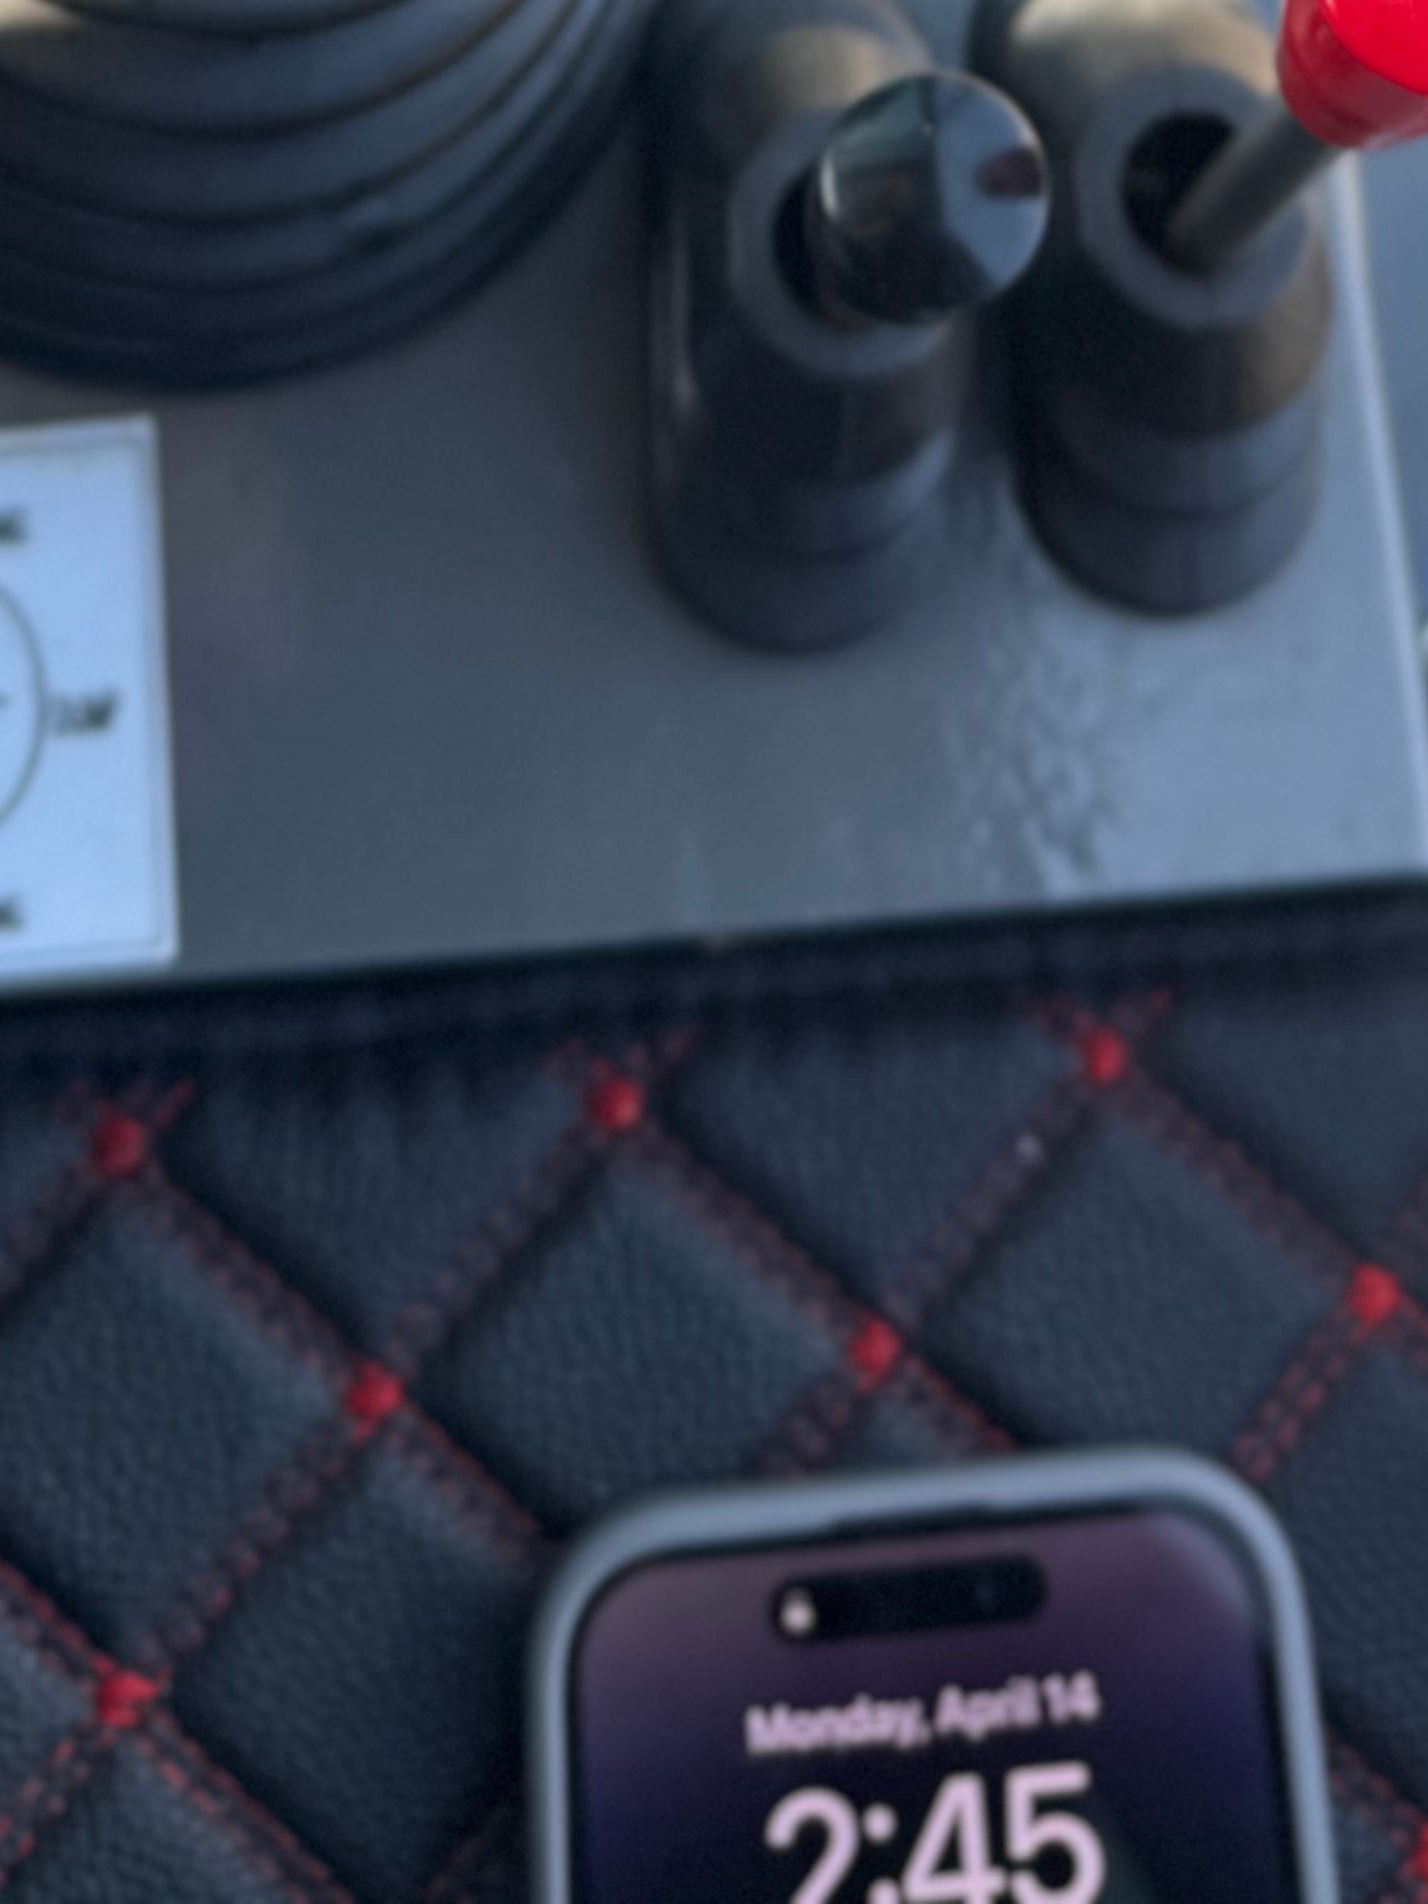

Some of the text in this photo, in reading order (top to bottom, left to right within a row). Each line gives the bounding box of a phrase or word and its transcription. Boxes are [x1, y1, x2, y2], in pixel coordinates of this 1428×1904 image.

[745, 1669, 1100, 1755] Monday, April 14
[764, 1759, 1107, 1904] 2:45
